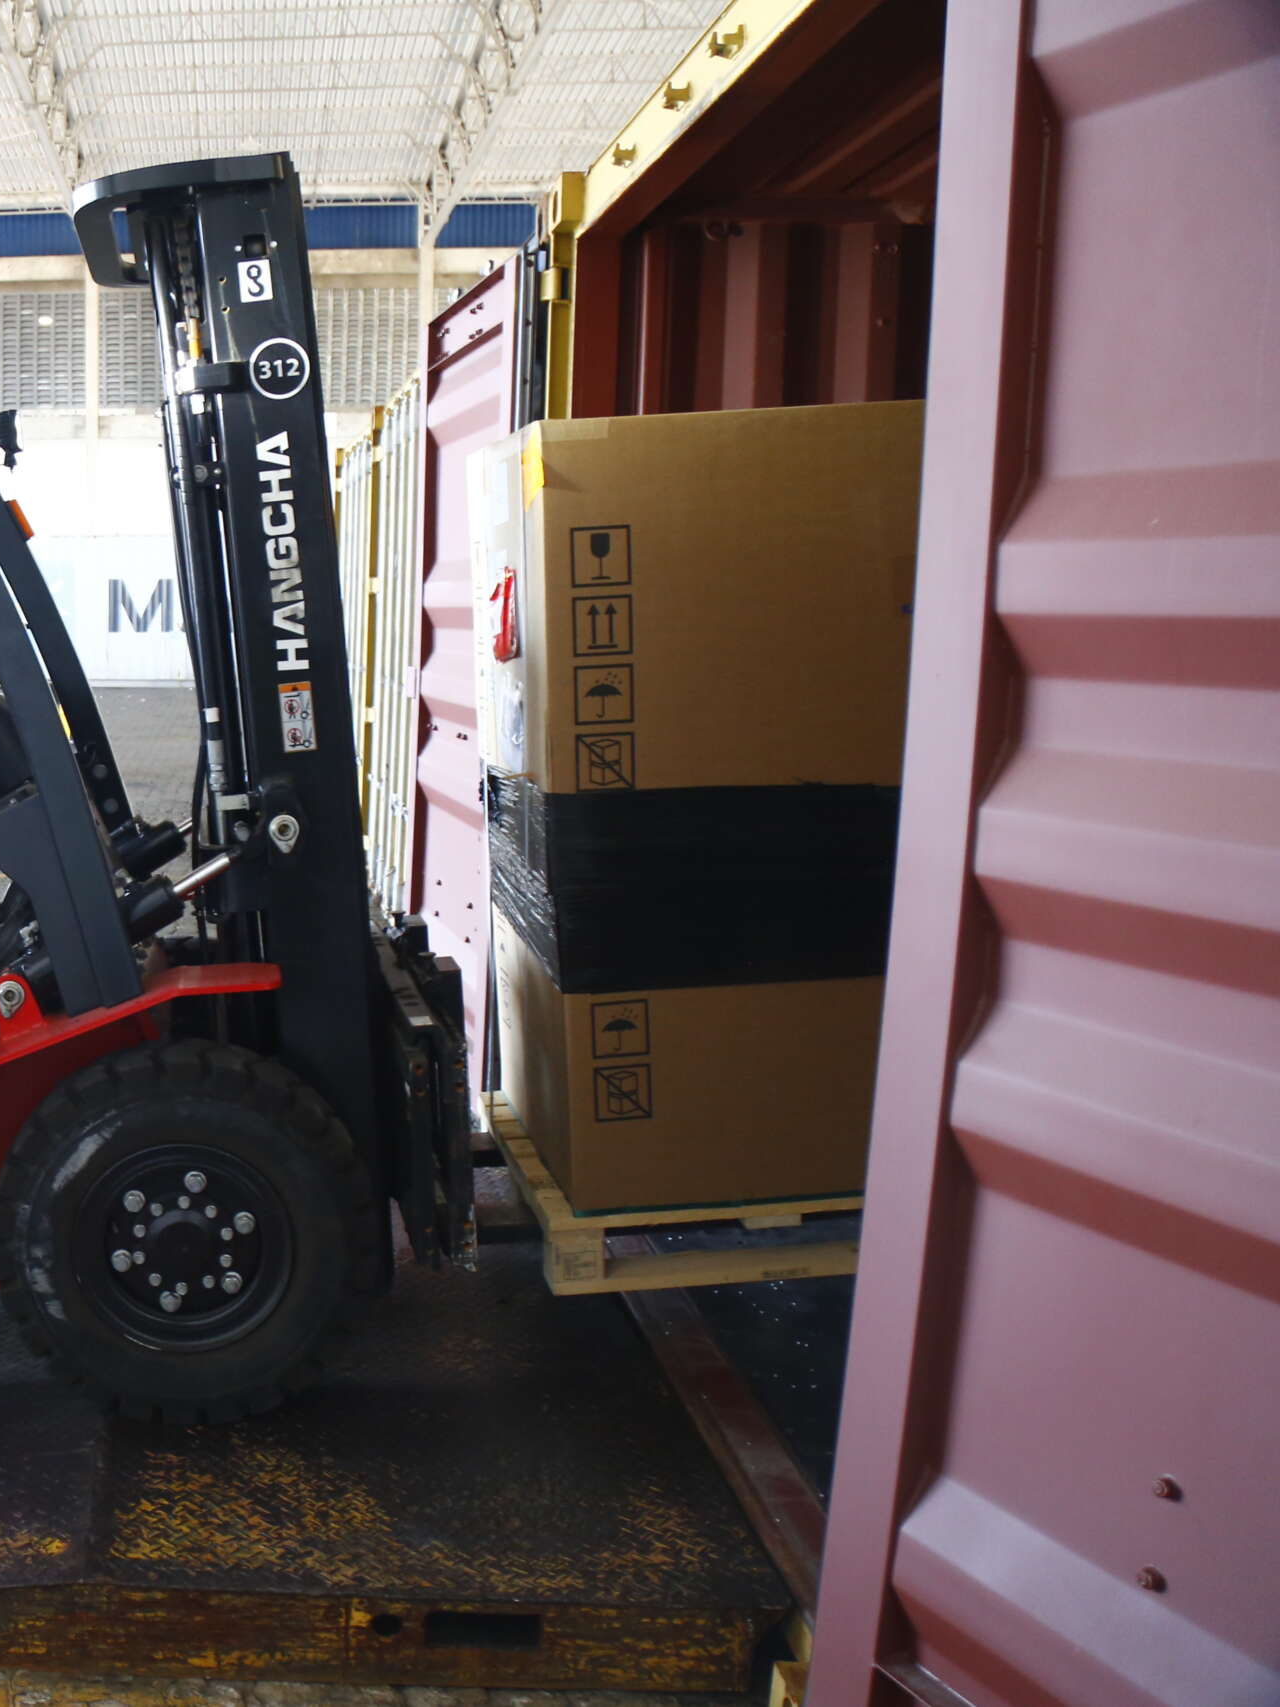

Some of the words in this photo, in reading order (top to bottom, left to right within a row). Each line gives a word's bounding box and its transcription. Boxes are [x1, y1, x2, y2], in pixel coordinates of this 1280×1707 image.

[258, 358, 300, 379] 312
[255, 430, 310, 672] HANGCHA
[107, 578, 187, 633] M
